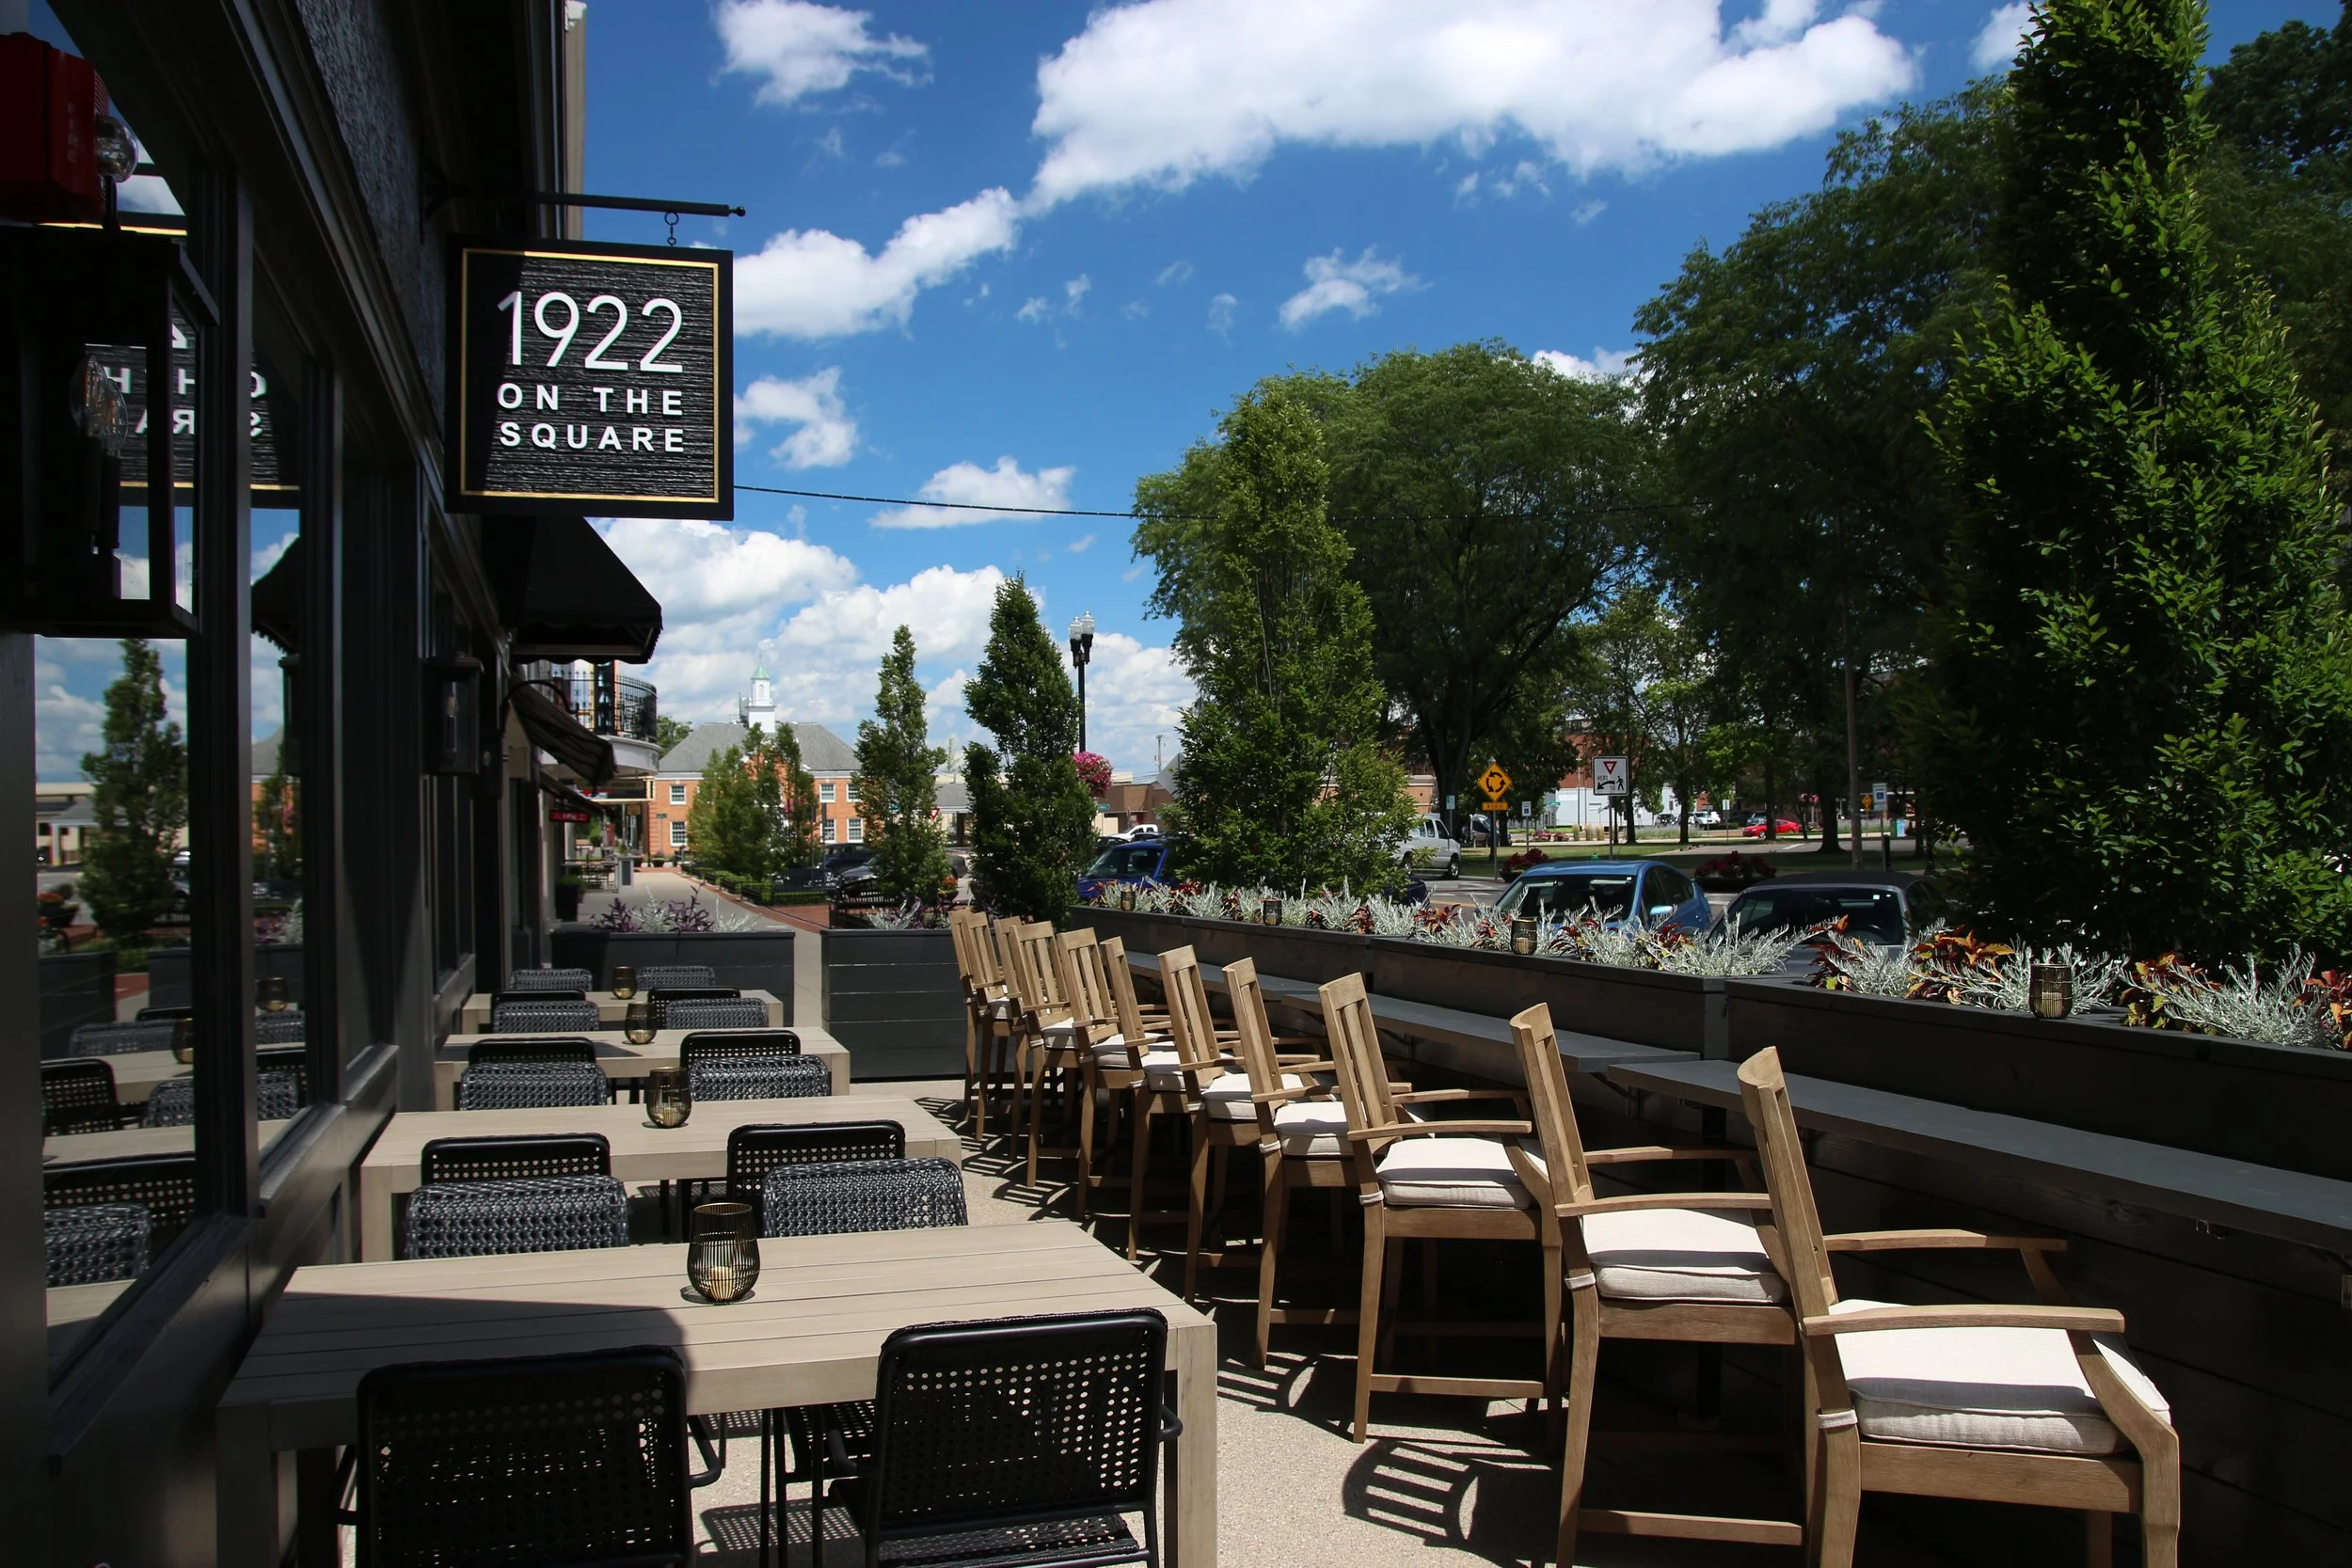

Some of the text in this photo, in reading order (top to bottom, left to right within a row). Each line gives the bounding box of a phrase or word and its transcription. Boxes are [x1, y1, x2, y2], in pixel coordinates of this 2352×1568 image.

[497, 291, 683, 373] 1922
[497, 382, 683, 416] ON THE
[499, 421, 685, 452] SQUARE
